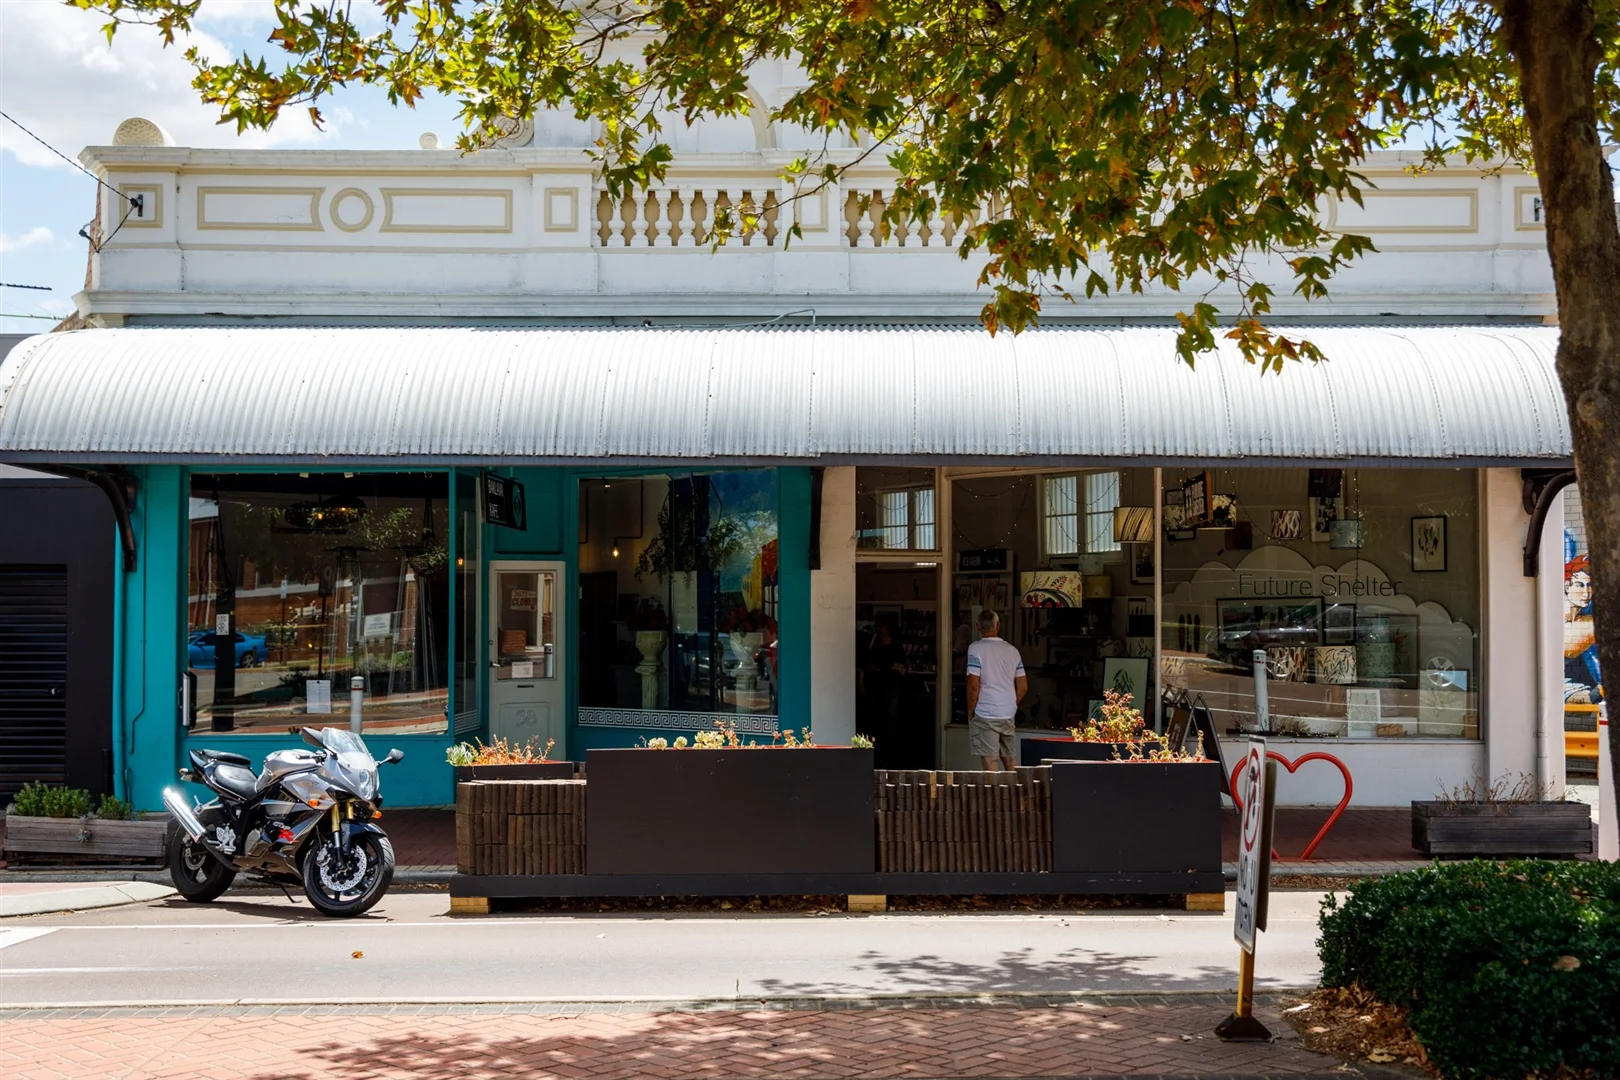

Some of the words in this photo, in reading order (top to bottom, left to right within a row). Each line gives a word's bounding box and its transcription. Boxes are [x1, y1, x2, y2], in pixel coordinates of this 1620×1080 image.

[1239, 574, 1312, 596] Future
[1321, 574, 1402, 597] Shelter
[516, 709, 537, 727] 58
[1240, 853, 1248, 890] NO
[1250, 859, 1257, 895] U
[1237, 897, 1253, 936] TURN
